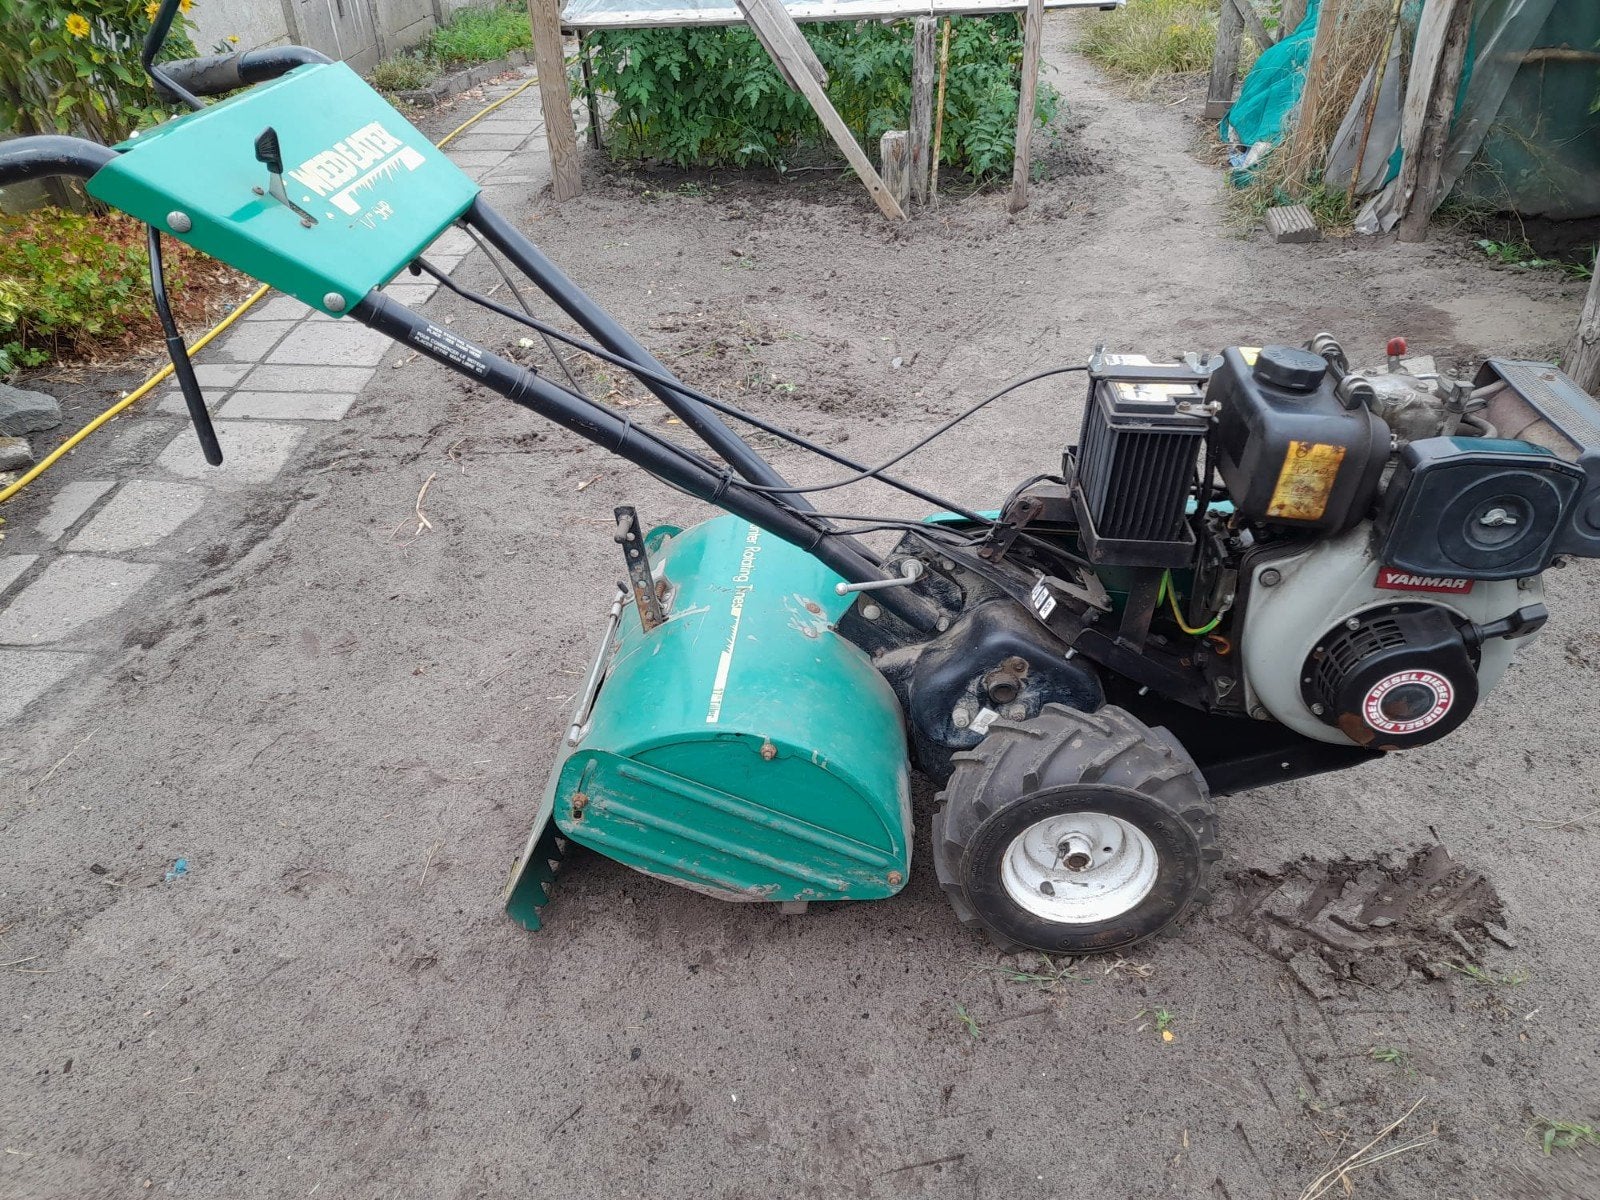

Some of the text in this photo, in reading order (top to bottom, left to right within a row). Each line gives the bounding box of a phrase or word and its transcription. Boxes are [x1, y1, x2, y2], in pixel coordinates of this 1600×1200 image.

[416, 331, 430, 341] POUR
[732, 546, 761, 581] Rotating
[1385, 573, 1468, 588] YANMAR
[1372, 672, 1419, 698] DIESEL
[1420, 672, 1448, 705] DIESEL
[1368, 701, 1394, 730] DIESEL
[1399, 707, 1441, 731] DIESEL
